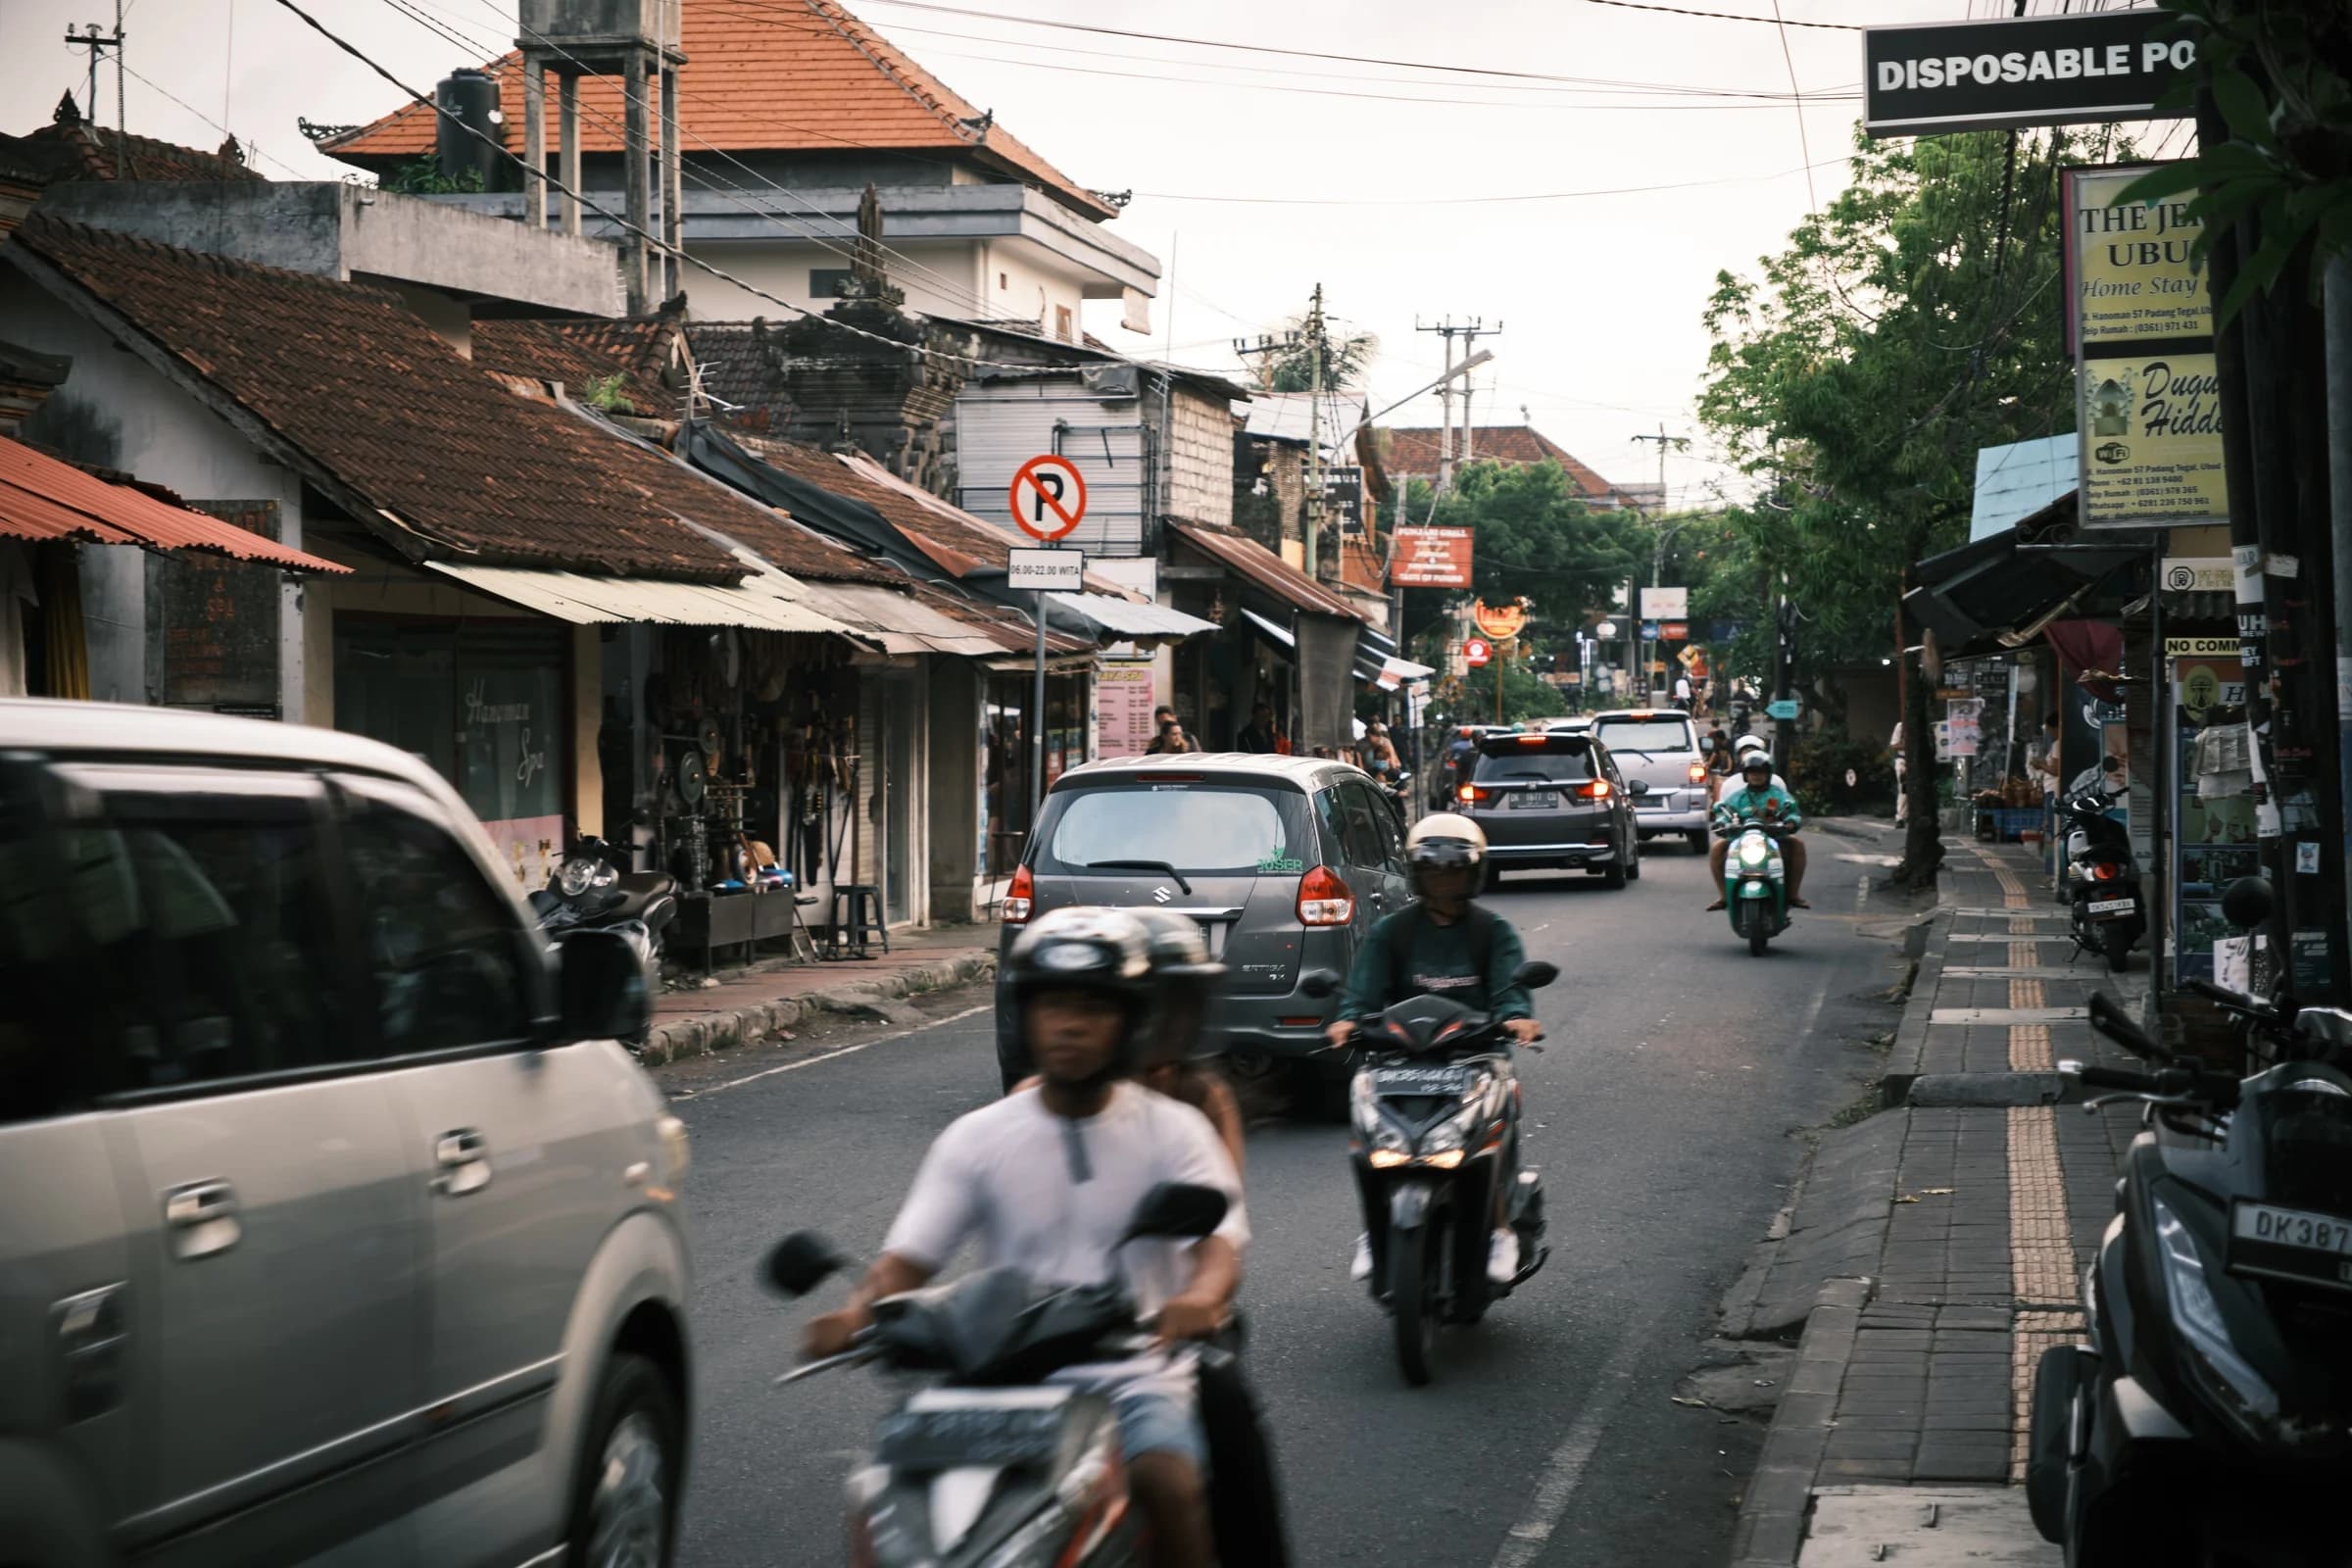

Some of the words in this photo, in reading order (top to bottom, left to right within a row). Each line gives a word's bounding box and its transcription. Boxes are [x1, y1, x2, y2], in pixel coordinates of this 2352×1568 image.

[1877, 44, 2131, 91] DISPOSABLE
[2080, 206, 2147, 233] THE
[2156, 203, 2203, 235] JE
[2107, 240, 2209, 267] UBU
[2081, 278, 2142, 297] Home
[2149, 276, 2198, 299] Stay
[2132, 310, 2142, 318] 57
[2145, 308, 2176, 318] Padang
[2100, 325, 2128, 334] Rumah
[2134, 323, 2163, 334] (0361)
[2165, 321, 2180, 331] 971
[2182, 320, 2198, 330] 431
[1058, 565, 1079, 575] WITA
[2168, 641, 2189, 652] NO
